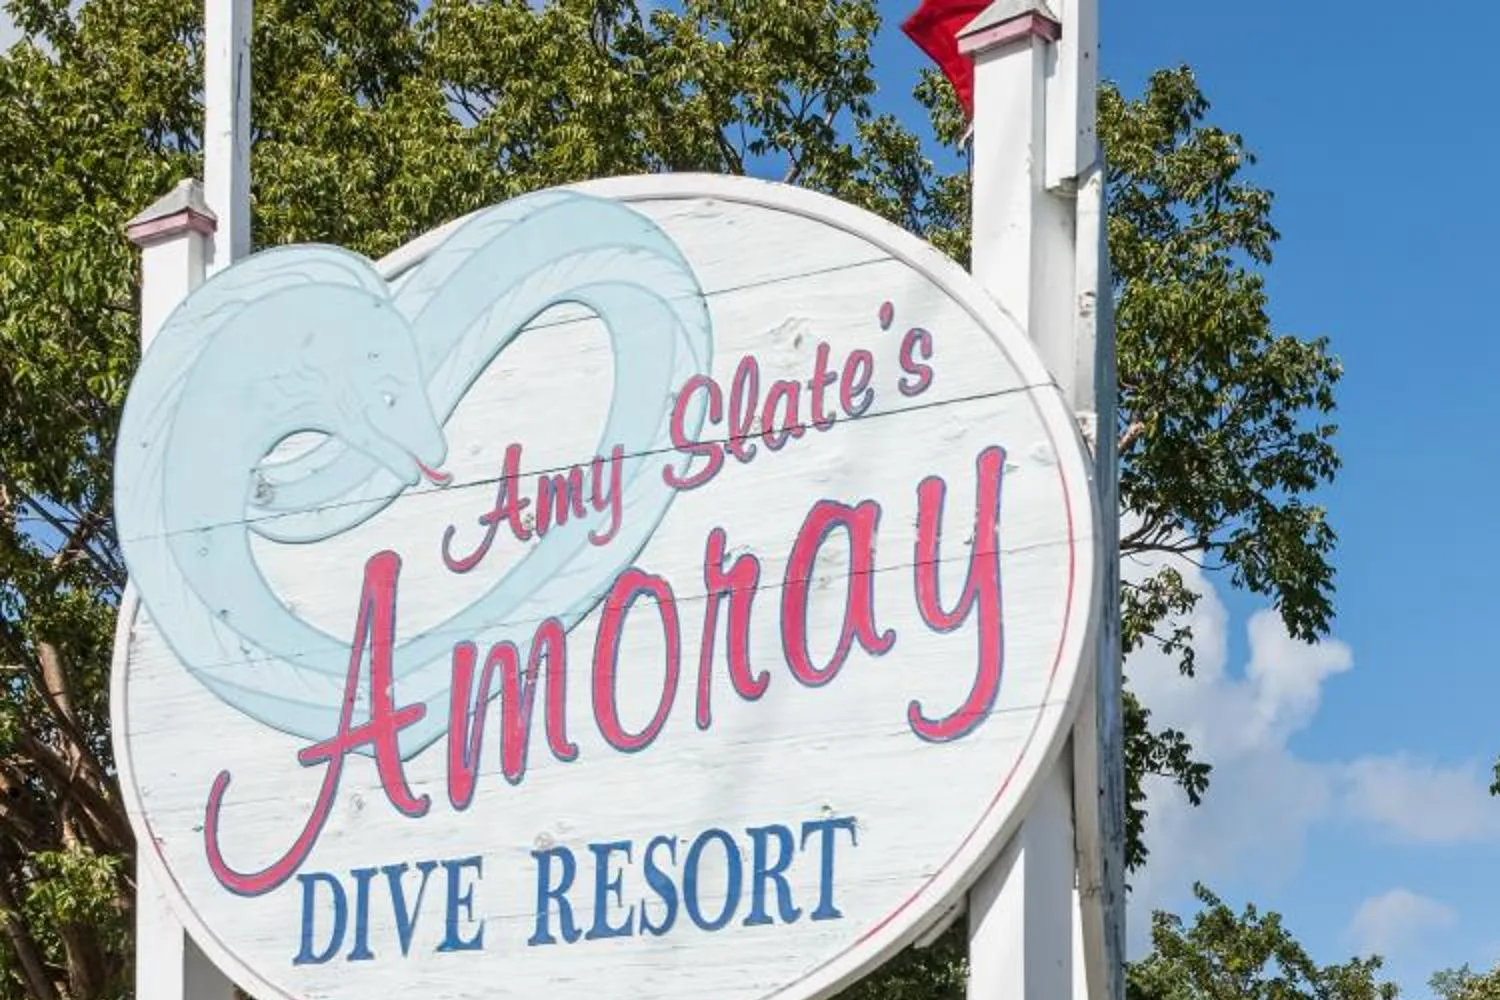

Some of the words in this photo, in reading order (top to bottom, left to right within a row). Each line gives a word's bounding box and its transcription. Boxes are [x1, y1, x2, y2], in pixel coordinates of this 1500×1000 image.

[443, 443, 625, 573] Amy
[662, 301, 934, 490] Slate's
[205, 446, 1006, 896] Amoray
[293, 855, 485, 967] DIVE
[527, 817, 858, 947] RESORT
